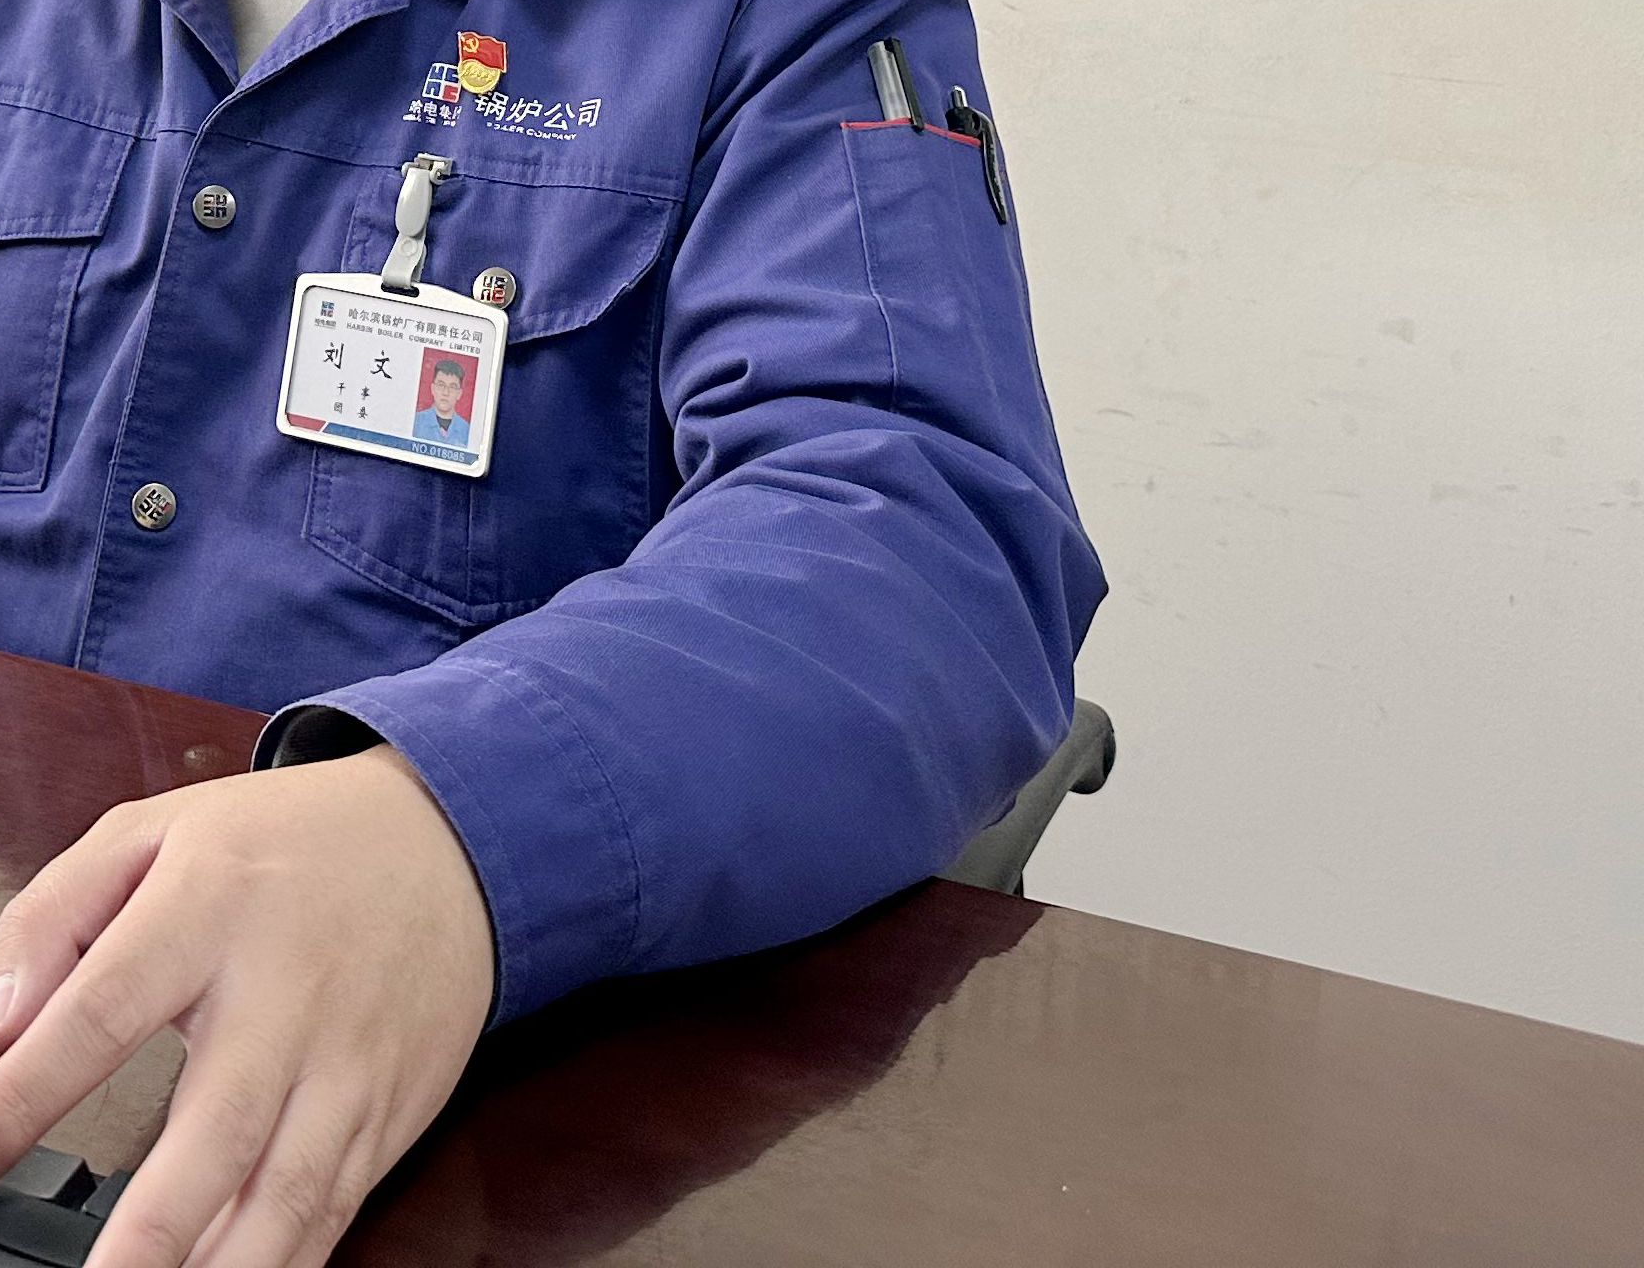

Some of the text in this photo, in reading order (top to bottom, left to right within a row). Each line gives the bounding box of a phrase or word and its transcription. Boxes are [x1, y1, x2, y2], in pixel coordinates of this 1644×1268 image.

[475, 91, 602, 130] 锅炉公司
[348, 308, 483, 343] 哈尔滨锅炉厂有限责任公司
